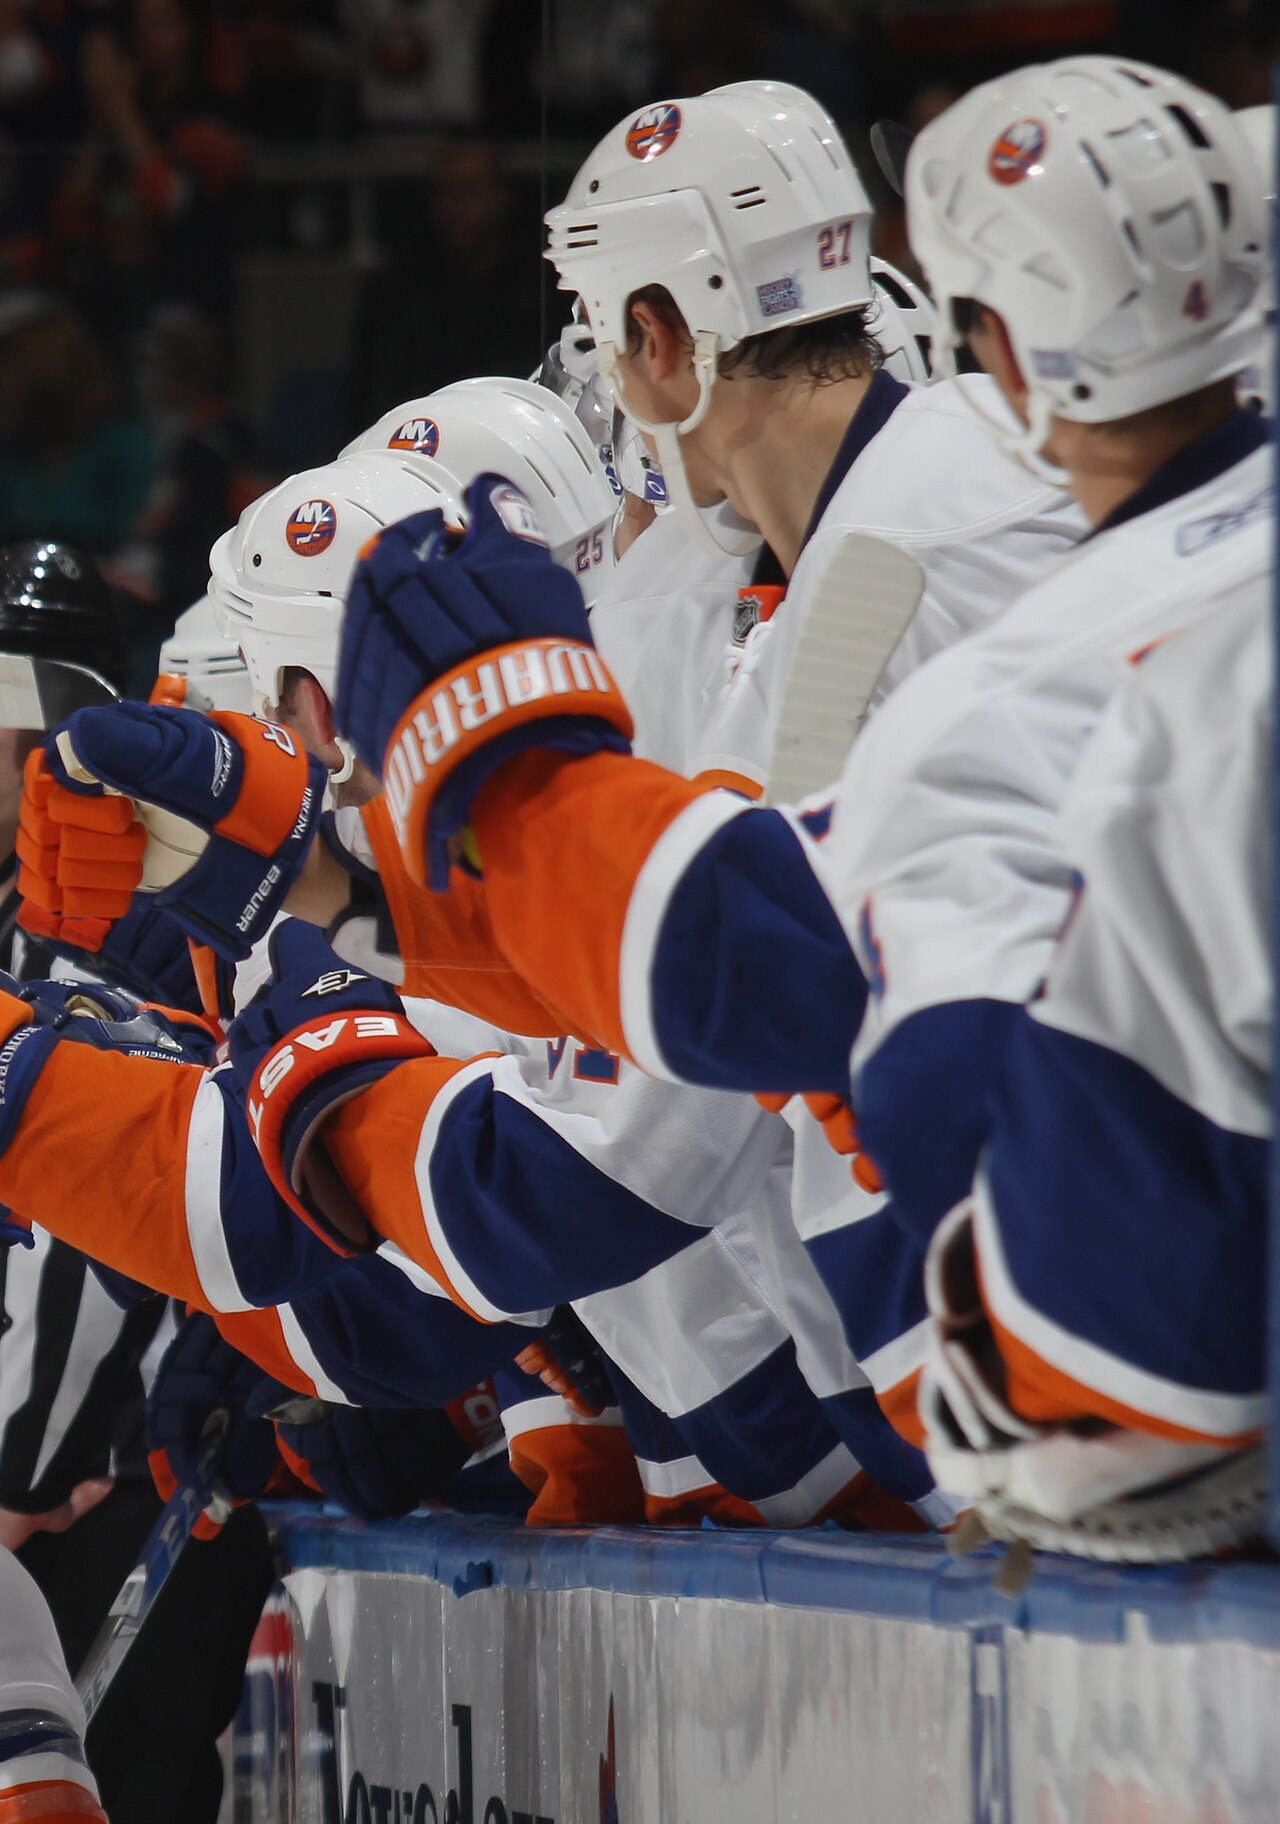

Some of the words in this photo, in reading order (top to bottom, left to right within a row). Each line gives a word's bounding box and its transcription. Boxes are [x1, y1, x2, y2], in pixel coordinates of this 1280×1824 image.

[818, 220, 855, 271] 27
[576, 529, 604, 576] 25
[235, 864, 282, 933] BAUER
